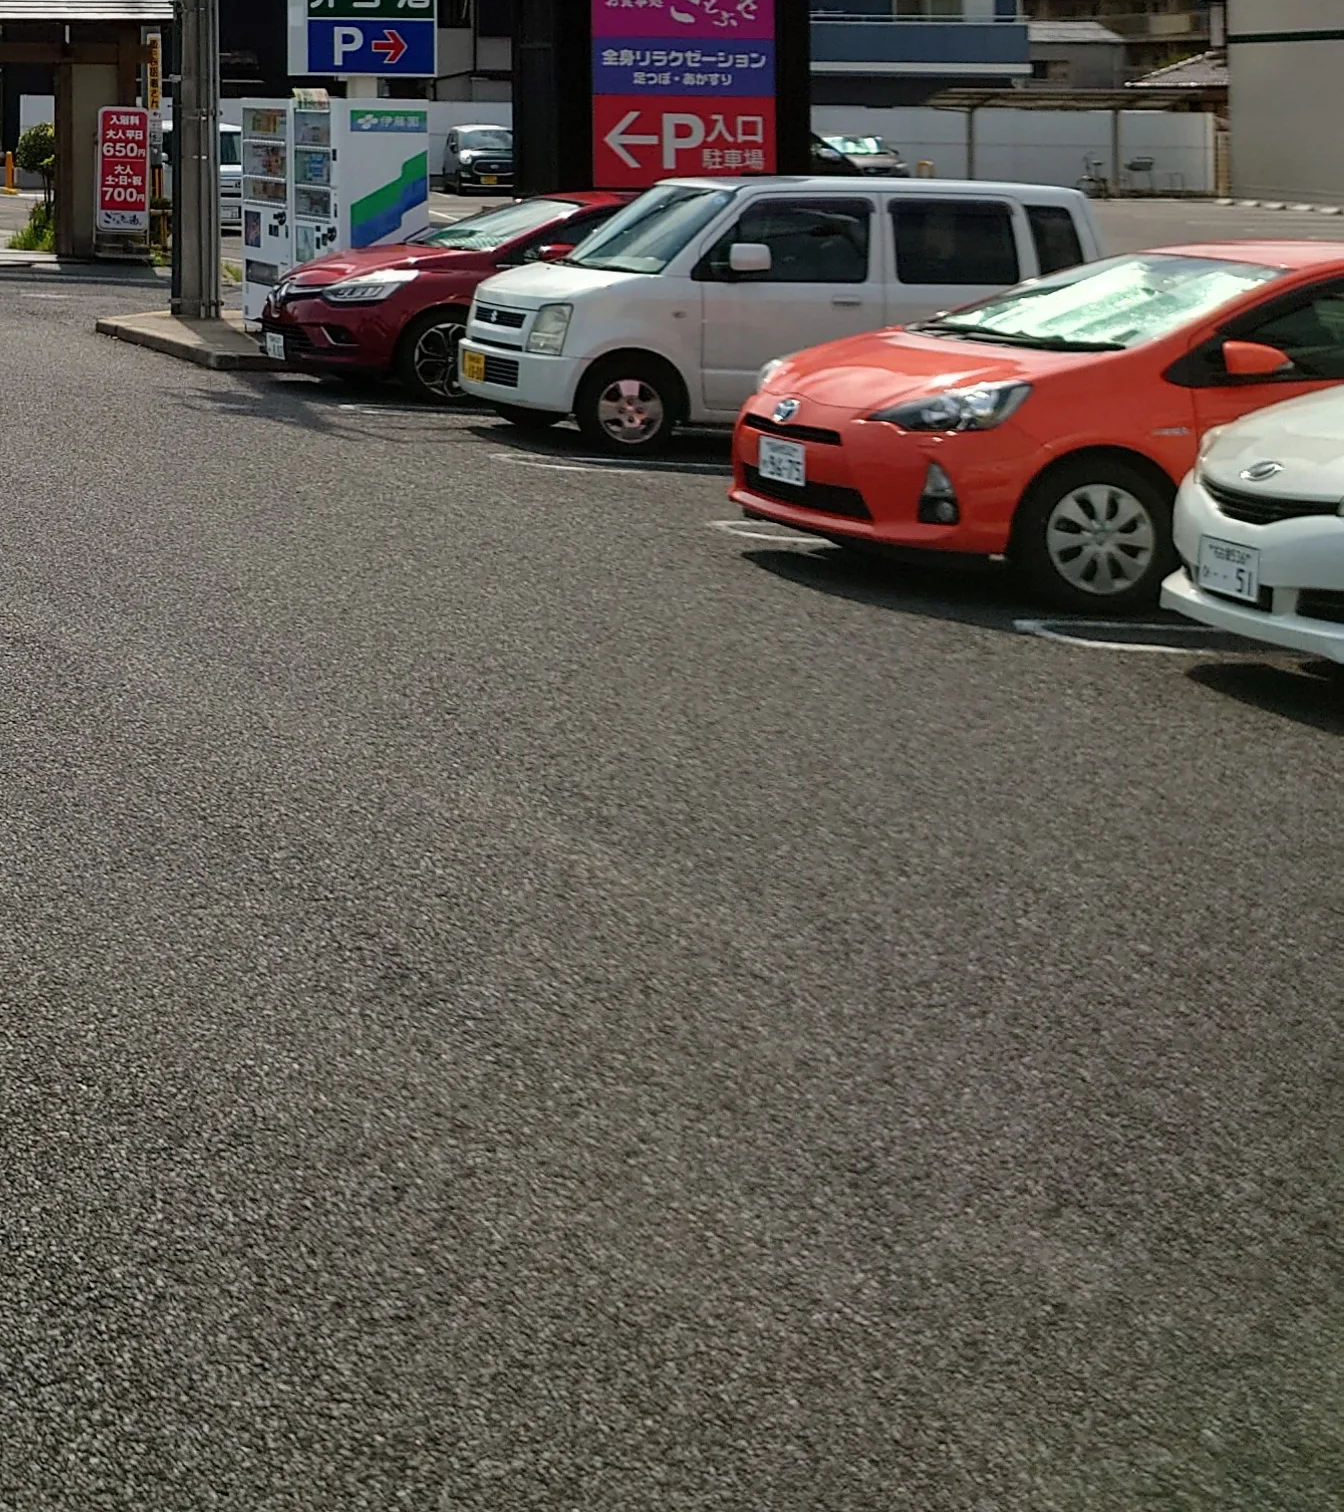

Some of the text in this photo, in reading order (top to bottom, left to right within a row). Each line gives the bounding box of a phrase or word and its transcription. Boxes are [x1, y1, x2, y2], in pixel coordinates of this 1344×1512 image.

[333, 26, 365, 67] P
[601, 48, 767, 69] 全身リラクゼーション
[662, 112, 706, 170] P
[706, 114, 765, 144] 入口
[114, 164, 134, 175] 大人
[701, 148, 766, 170] 駐車場
